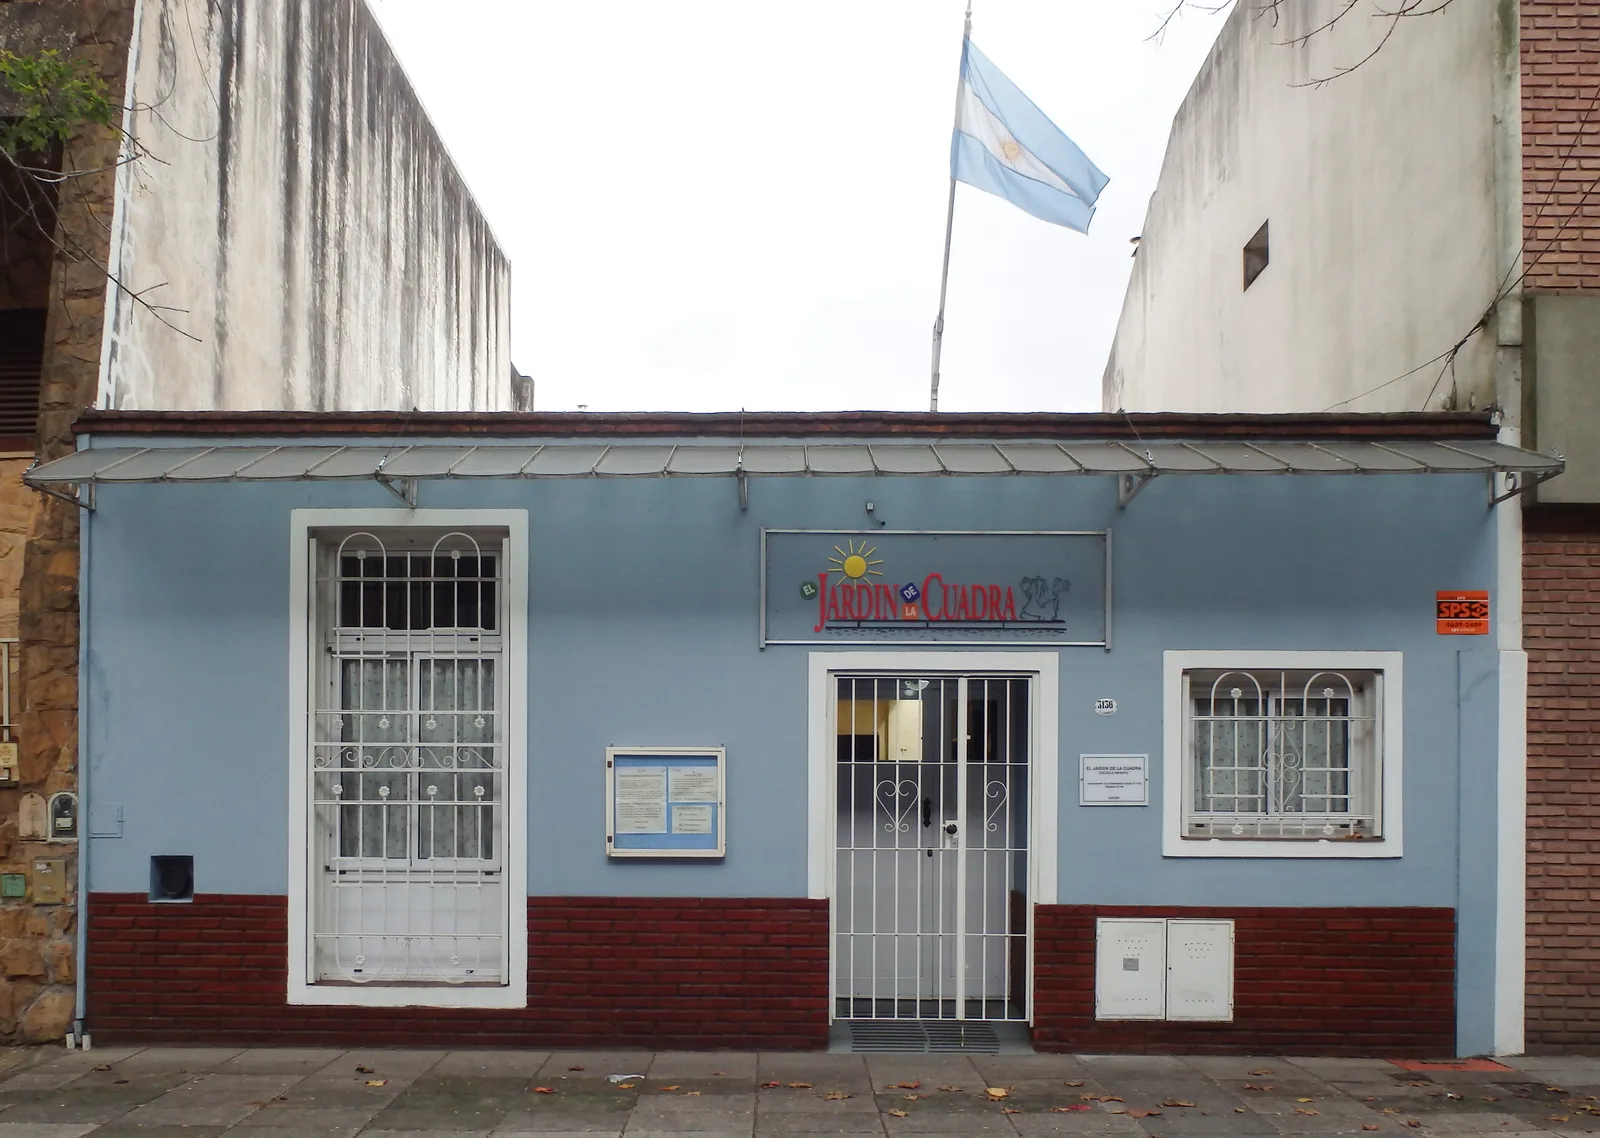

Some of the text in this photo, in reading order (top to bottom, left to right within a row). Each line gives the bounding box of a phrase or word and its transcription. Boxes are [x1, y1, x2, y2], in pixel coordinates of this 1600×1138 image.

[802, 572, 1018, 633] EL JARDIN DE LA CUADRA
[1439, 602, 1471, 617] SPS
[1097, 700, 1114, 709] 3136
